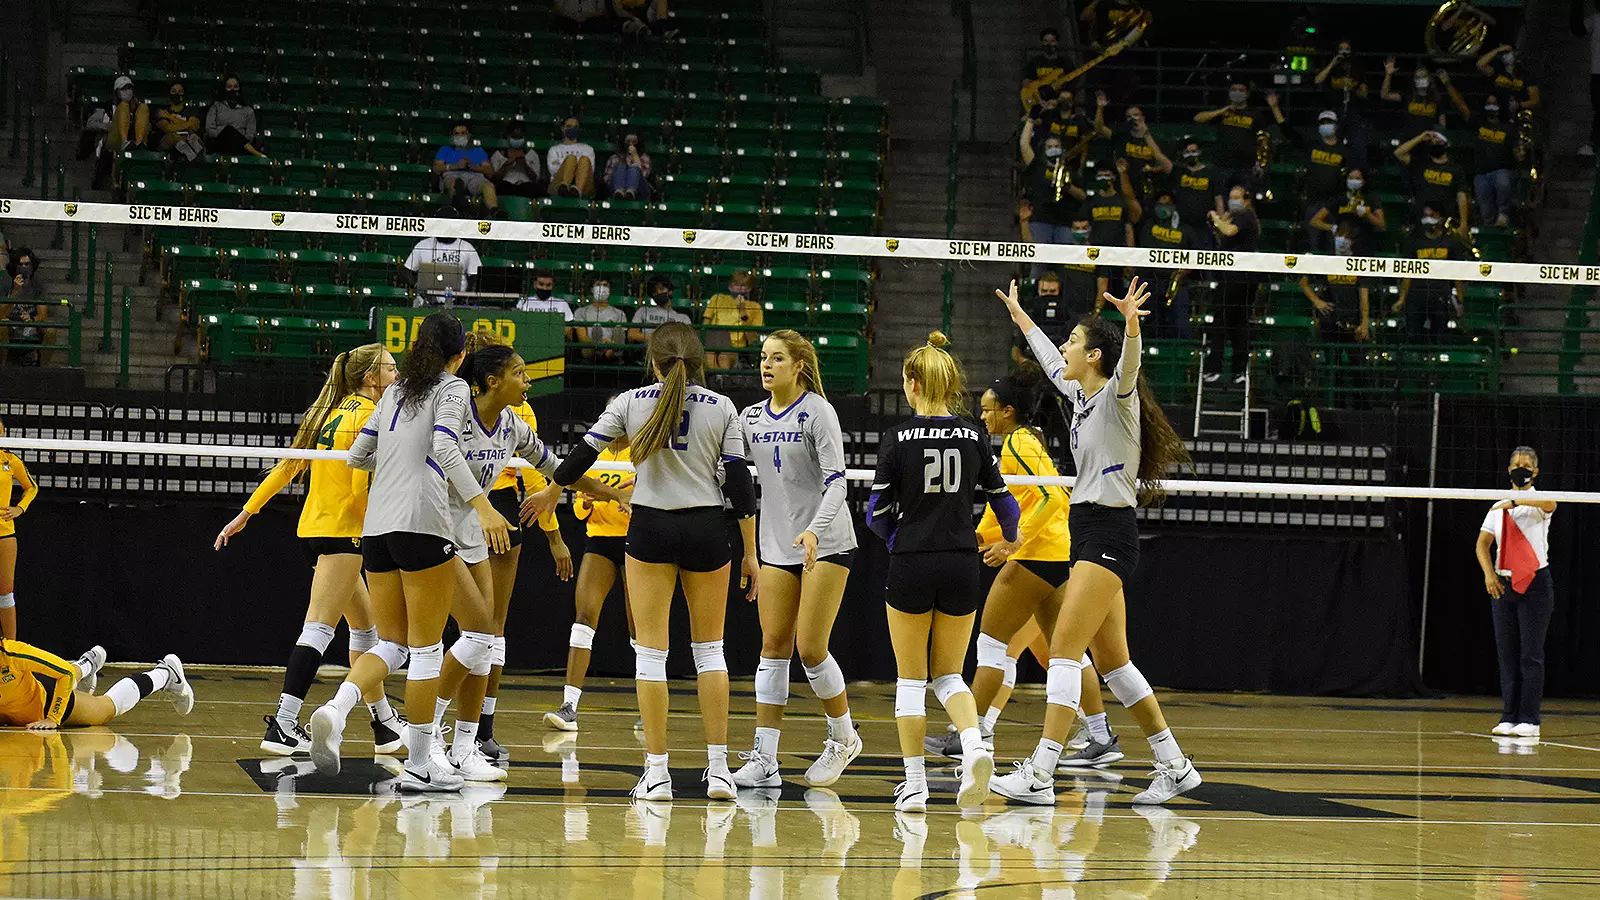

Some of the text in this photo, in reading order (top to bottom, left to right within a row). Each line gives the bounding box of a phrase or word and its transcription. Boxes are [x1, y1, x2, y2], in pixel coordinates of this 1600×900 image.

[129, 206, 218, 223] SIC'EM BEARS
[336, 215, 425, 231] SIC'EM BEARS
[542, 224, 630, 241] SIC'EM BEARS
[746, 233, 834, 249] SIC'EM BEARS
[949, 242, 1036, 258] SIC'EM BEARS
[1149, 250, 1234, 266] SIC'EM BEARS
[1346, 258, 1430, 274] SIC'EM BEARS
[1540, 266, 1579, 280] SIC'EM
[316, 415, 344, 450] 4
[752, 431, 804, 444] K-STATE
[898, 428, 979, 442] WILDCATS
[465, 448, 506, 461] K-STATE
[773, 445, 781, 474] 4
[924, 448, 961, 493] 20
[600, 473, 621, 488] 22
